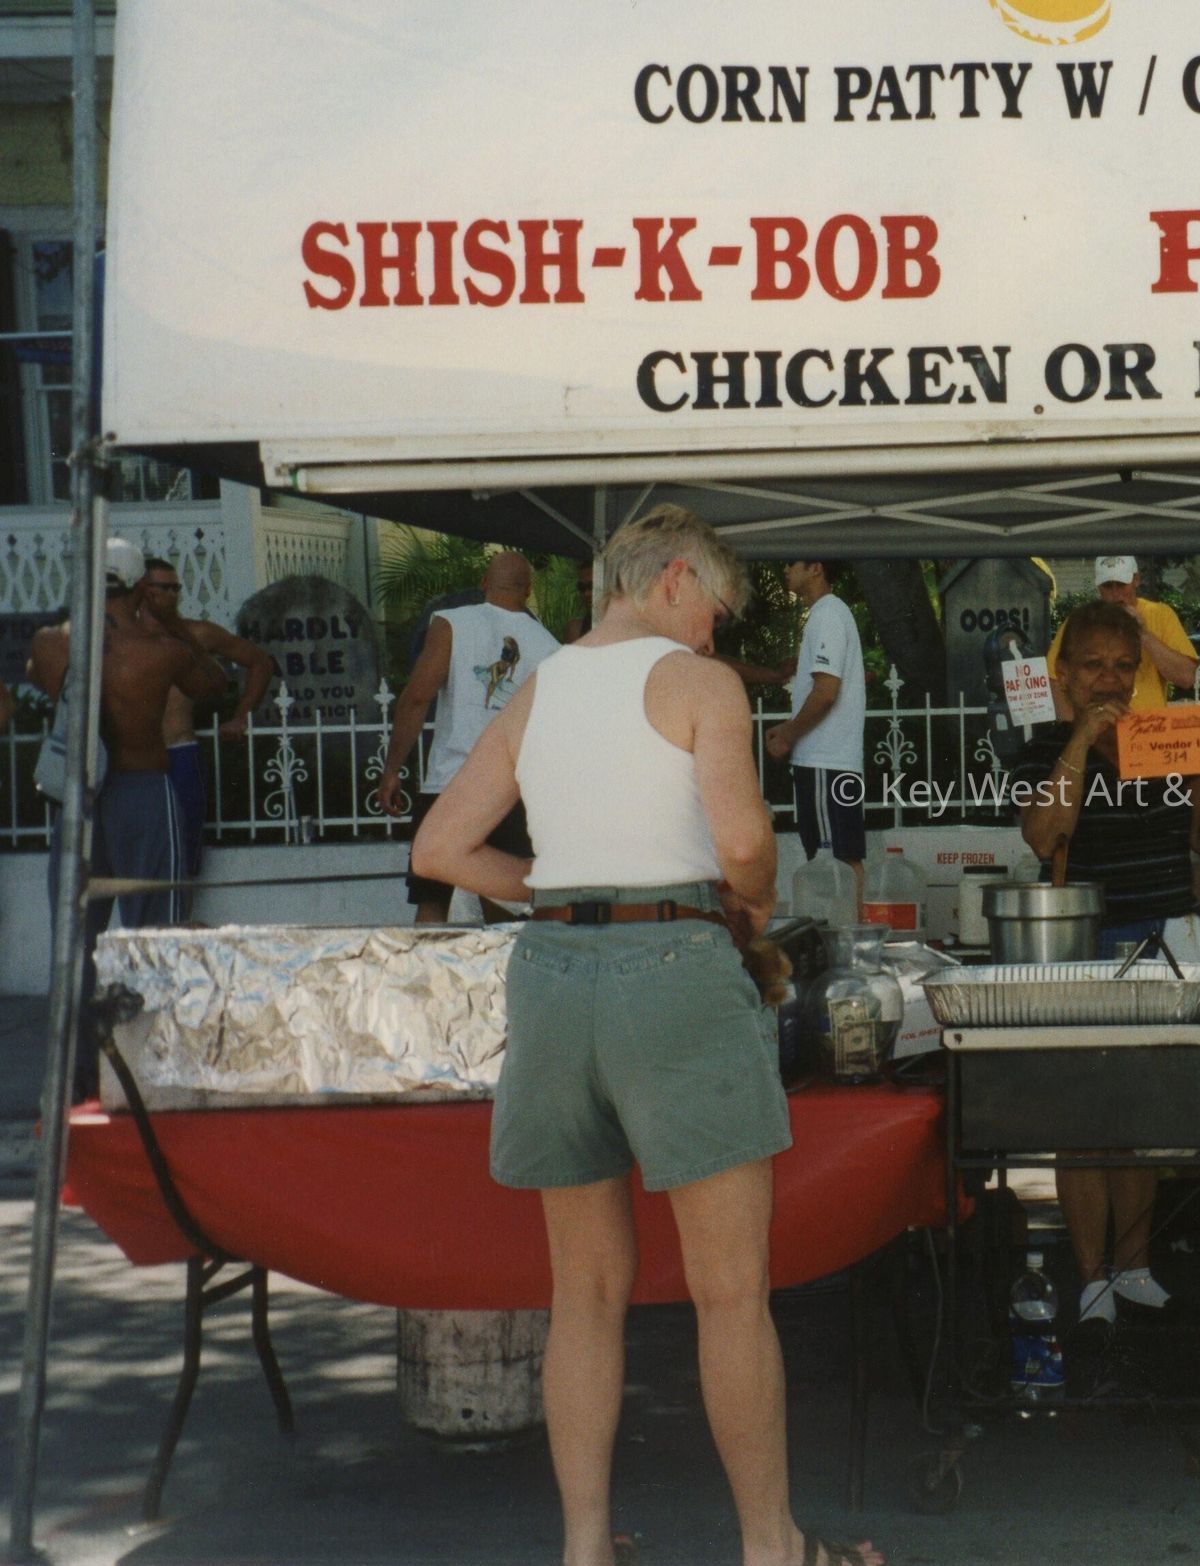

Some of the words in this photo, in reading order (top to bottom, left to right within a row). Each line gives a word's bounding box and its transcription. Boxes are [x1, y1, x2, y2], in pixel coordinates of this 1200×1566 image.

[634, 64, 810, 124] CORN
[834, 63, 1033, 122] PATTY
[1056, 61, 1115, 120] W
[1139, 55, 1158, 116] /
[302, 215, 941, 310] SHISH-K-BOB
[637, 346, 1012, 413] CHICKEN
[1045, 344, 1164, 401] OR
[240, 615, 359, 642] HARDLY
[960, 607, 1030, 633] OOPS!
[321, 685, 355, 699] YOU
[1149, 740, 1192, 750] Vendor
[1163, 751, 1187, 765] 314
[937, 852, 959, 865] KEEP
[961, 852, 995, 865] FROZEN
